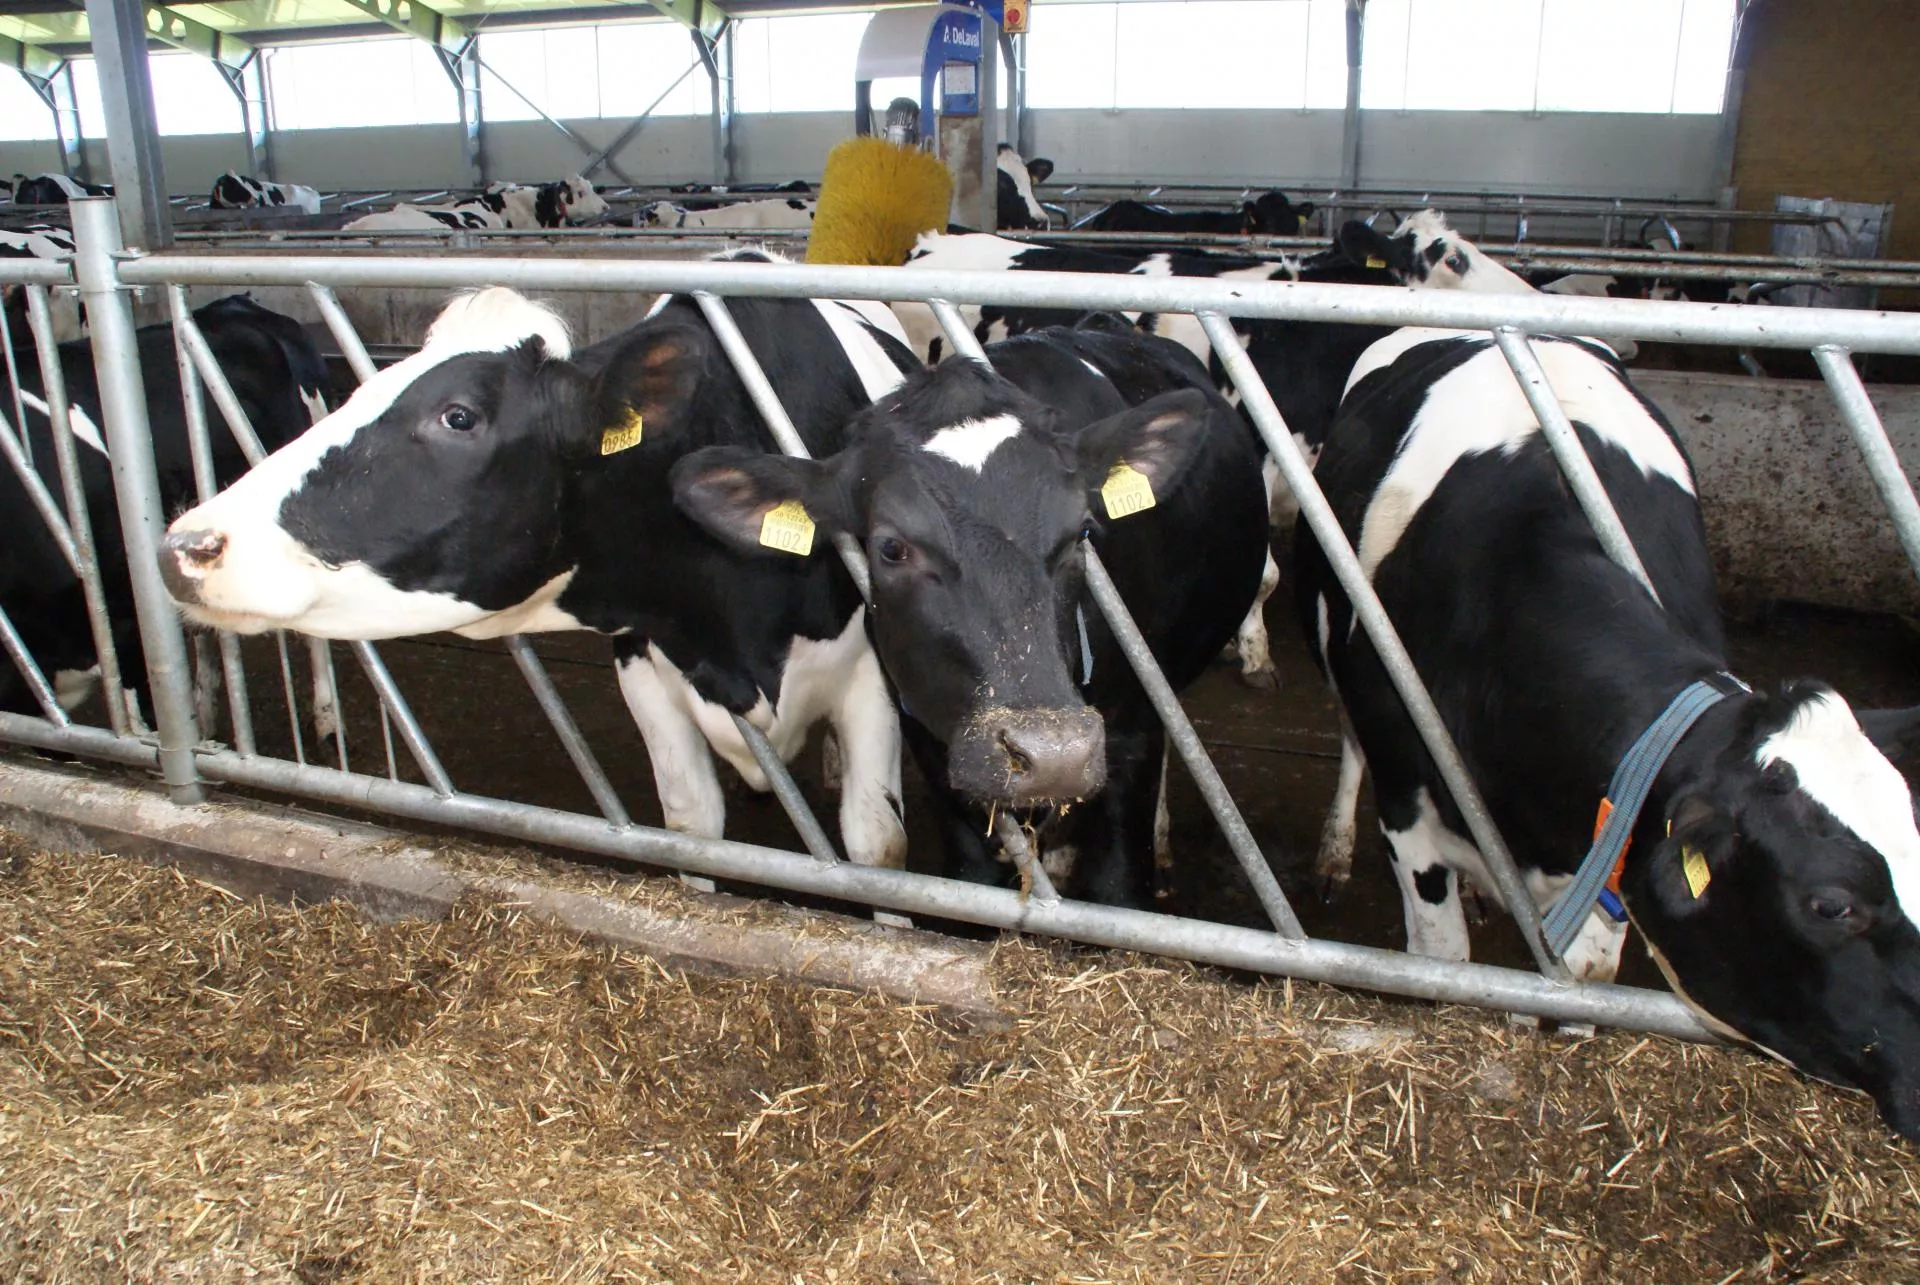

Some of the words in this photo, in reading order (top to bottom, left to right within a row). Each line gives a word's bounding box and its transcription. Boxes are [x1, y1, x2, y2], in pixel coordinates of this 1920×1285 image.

[952, 26, 980, 48] DeLaval
[1111, 492, 1146, 516] 1102
[766, 527, 800, 551] 1102
